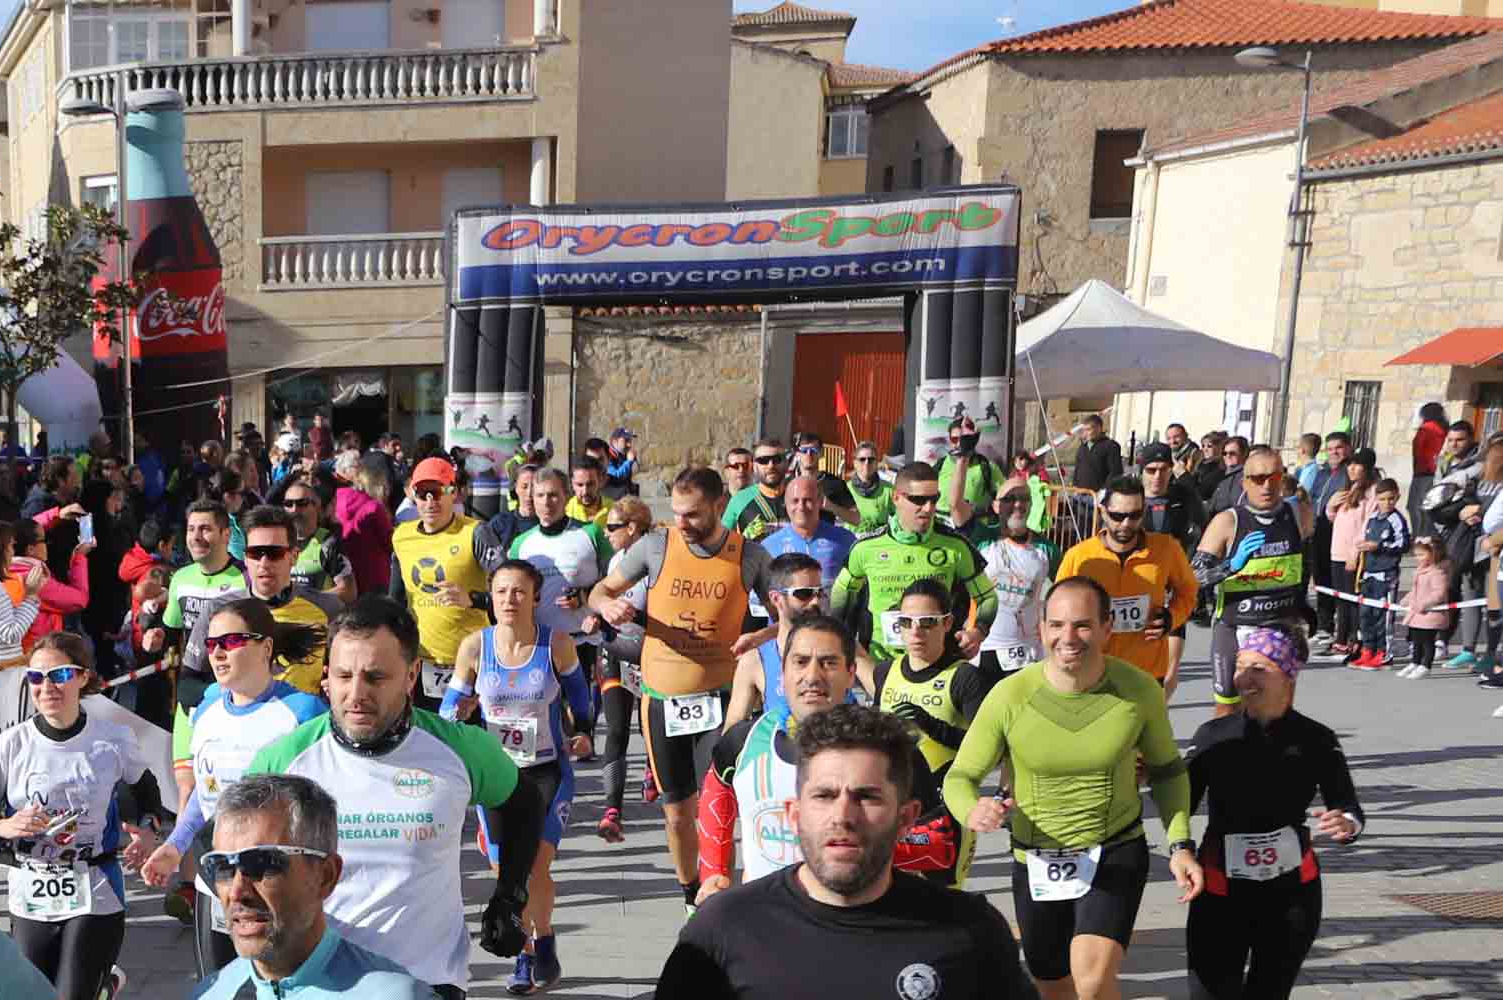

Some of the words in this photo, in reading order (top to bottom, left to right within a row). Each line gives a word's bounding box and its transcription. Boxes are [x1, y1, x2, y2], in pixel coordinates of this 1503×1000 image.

[534, 258, 946, 286] www.orycronsport.com
[668, 577, 727, 601] BRAVO
[680, 703, 703, 722] 83
[1047, 862, 1078, 882] 62
[32, 877, 76, 898] 205
